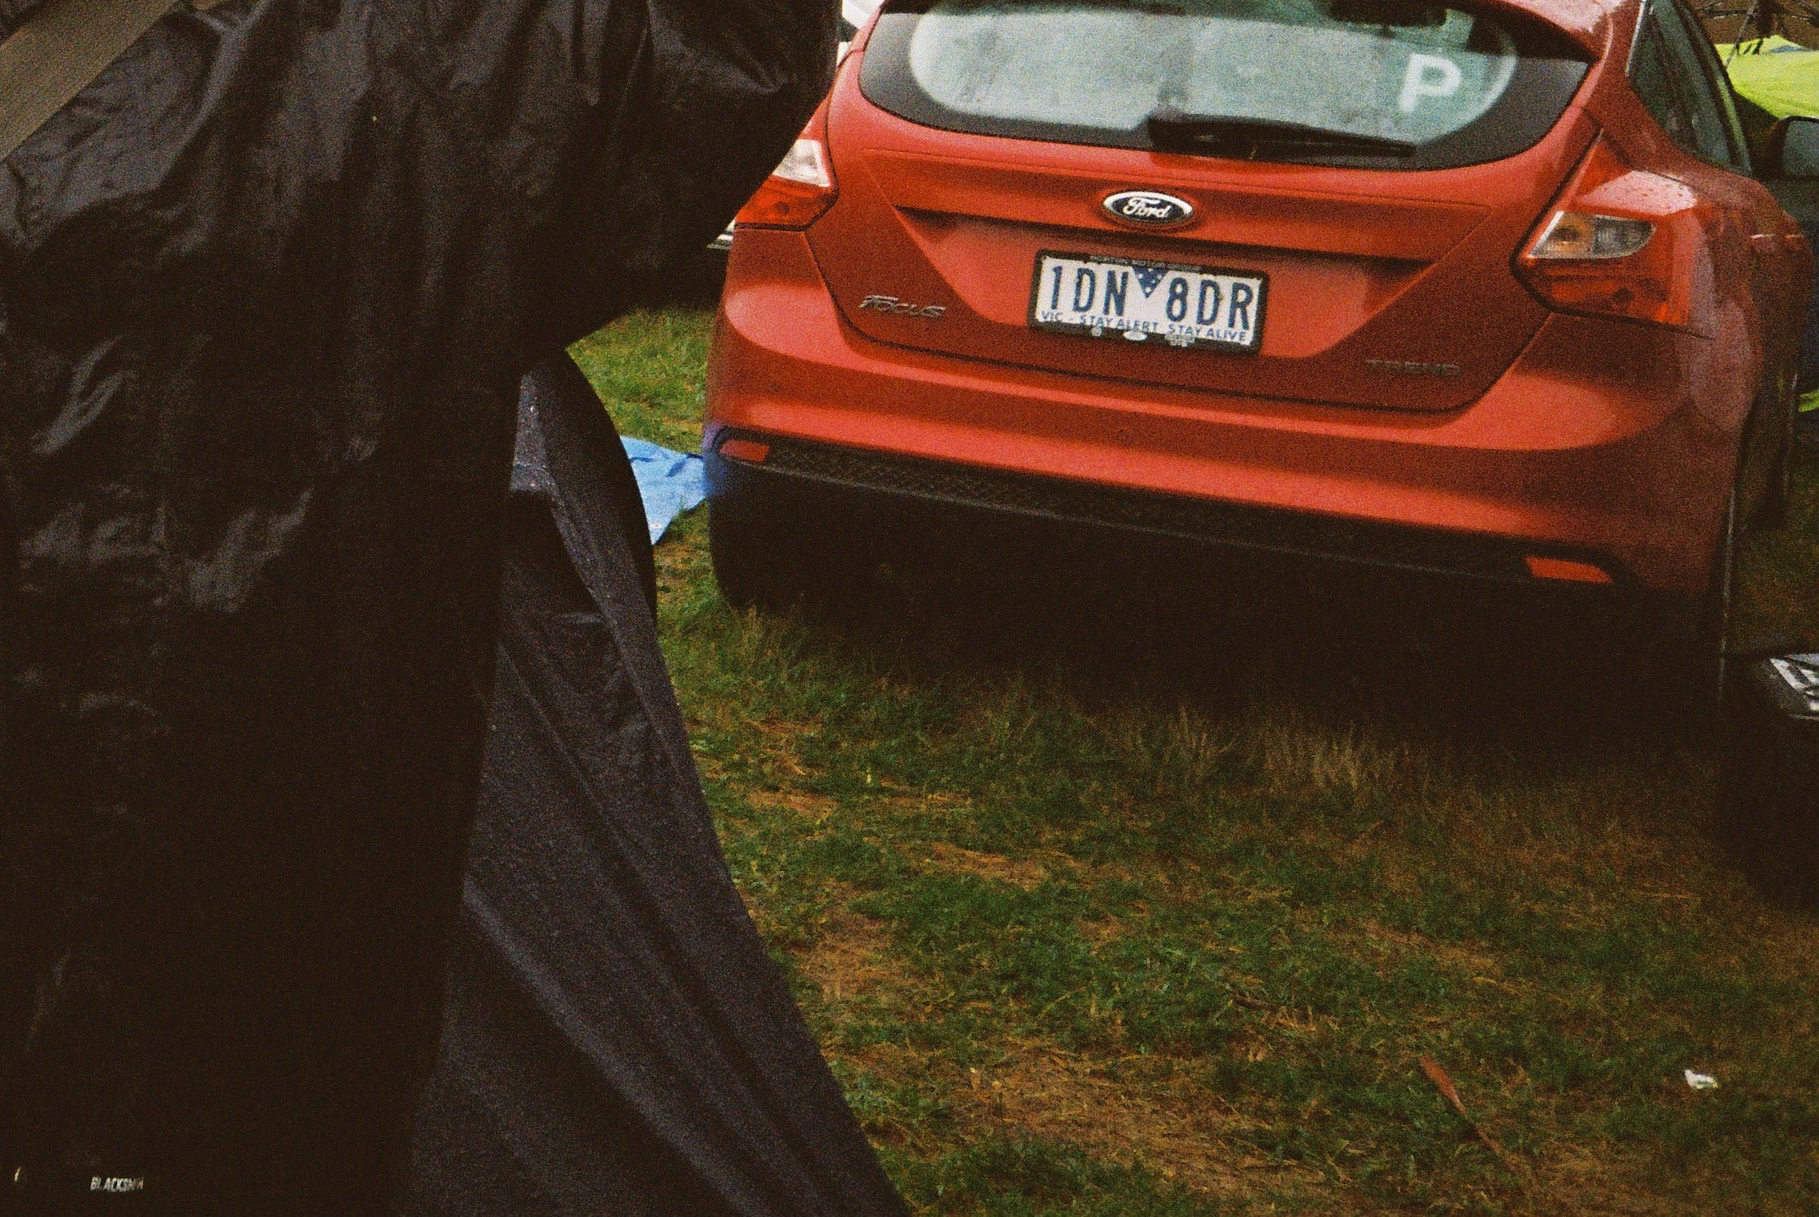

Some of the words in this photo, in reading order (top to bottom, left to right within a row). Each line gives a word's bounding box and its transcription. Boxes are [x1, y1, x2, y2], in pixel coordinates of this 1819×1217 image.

[1399, 53, 1461, 113] P
[1123, 196, 1172, 219] Ford
[1050, 265, 1129, 316] 1DN
[1166, 277, 1253, 330] 8DR
[1042, 311, 1062, 321] VIC
[1080, 314, 1113, 327] STAY
[1117, 318, 1159, 332] ALERT
[1168, 324, 1202, 336] STAY
[1206, 328, 1246, 341] ALIVE
